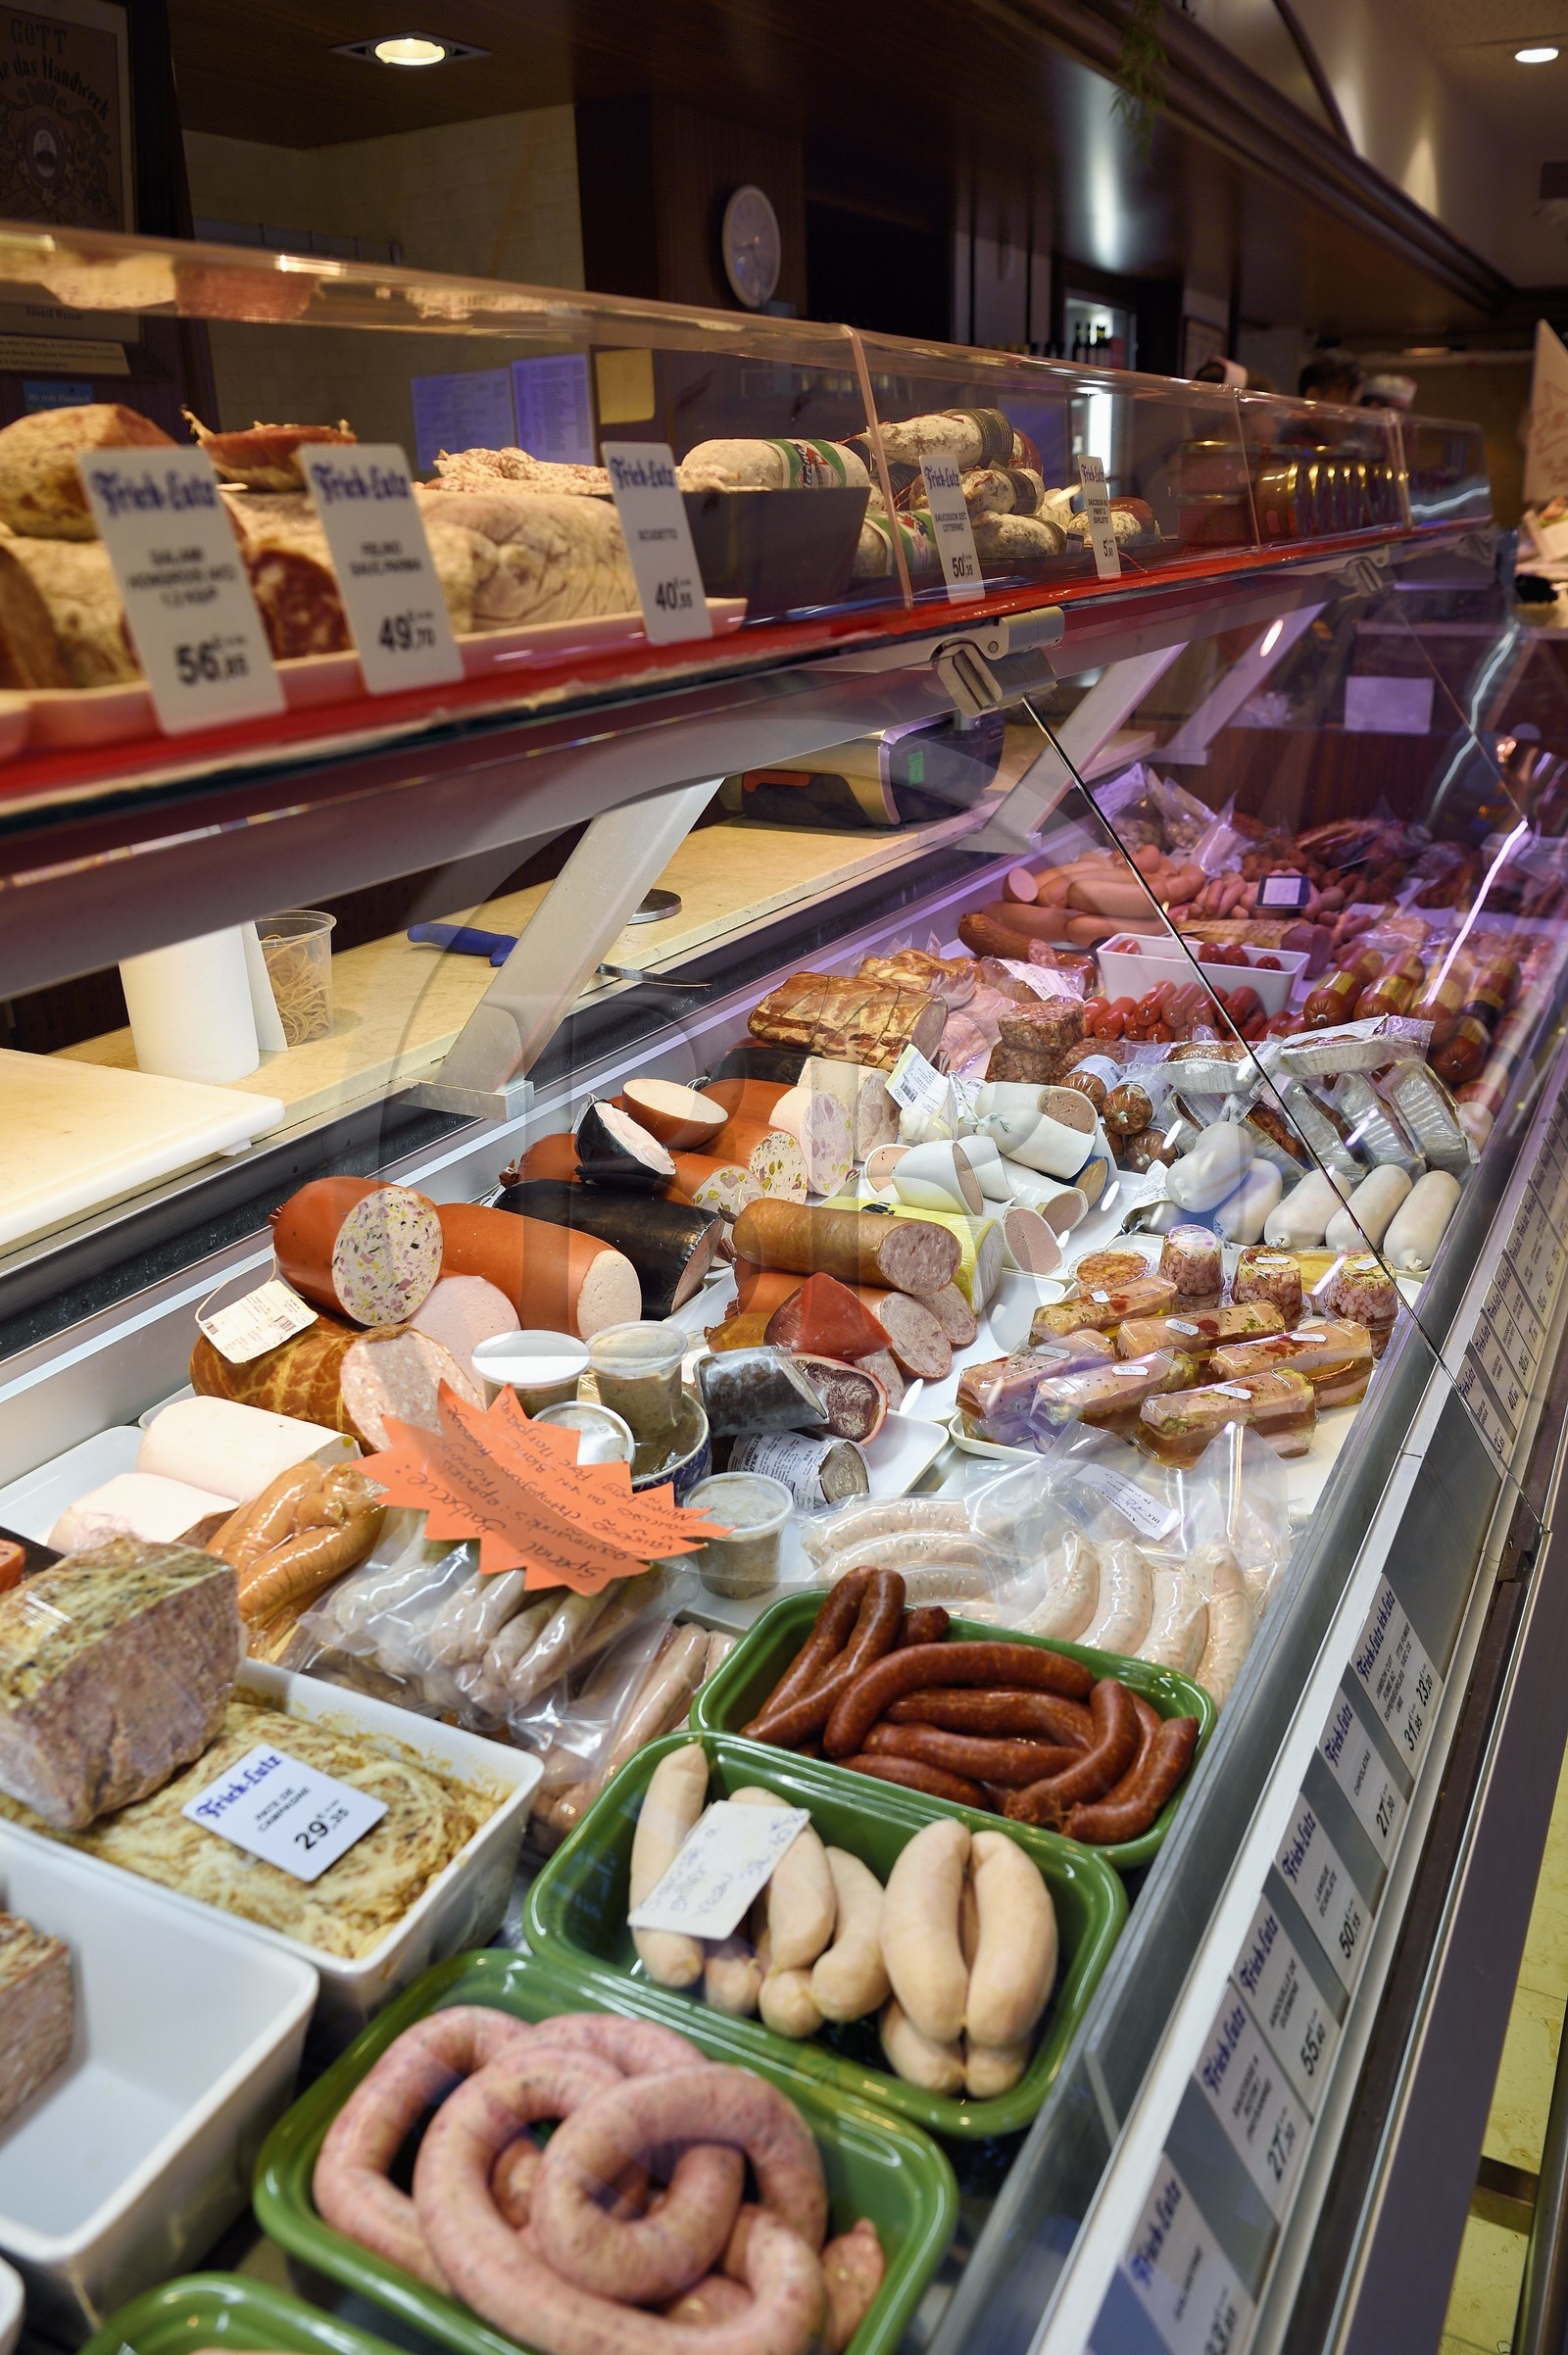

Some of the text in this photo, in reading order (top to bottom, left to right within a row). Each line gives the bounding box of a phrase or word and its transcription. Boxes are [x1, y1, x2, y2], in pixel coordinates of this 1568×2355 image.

[925, 466, 959, 489] Frick-Lutz
[1356, 1589, 1396, 1683] Frick-Lutz ick-Lutz
[1324, 1702, 1352, 1768] Frick-Lutz
[195, 1754, 282, 1819] Frick-Lutz
[1353, 1749, 1372, 1796] CHIPOLATAS
[257, 1787, 312, 1833] CAMPAGNE
[1282, 1811, 1316, 1884] Frick-Lutz
[1239, 1914, 1279, 1996] Frick-Lutz
[1202, 2005, 1247, 2096] Frick-Lutz
